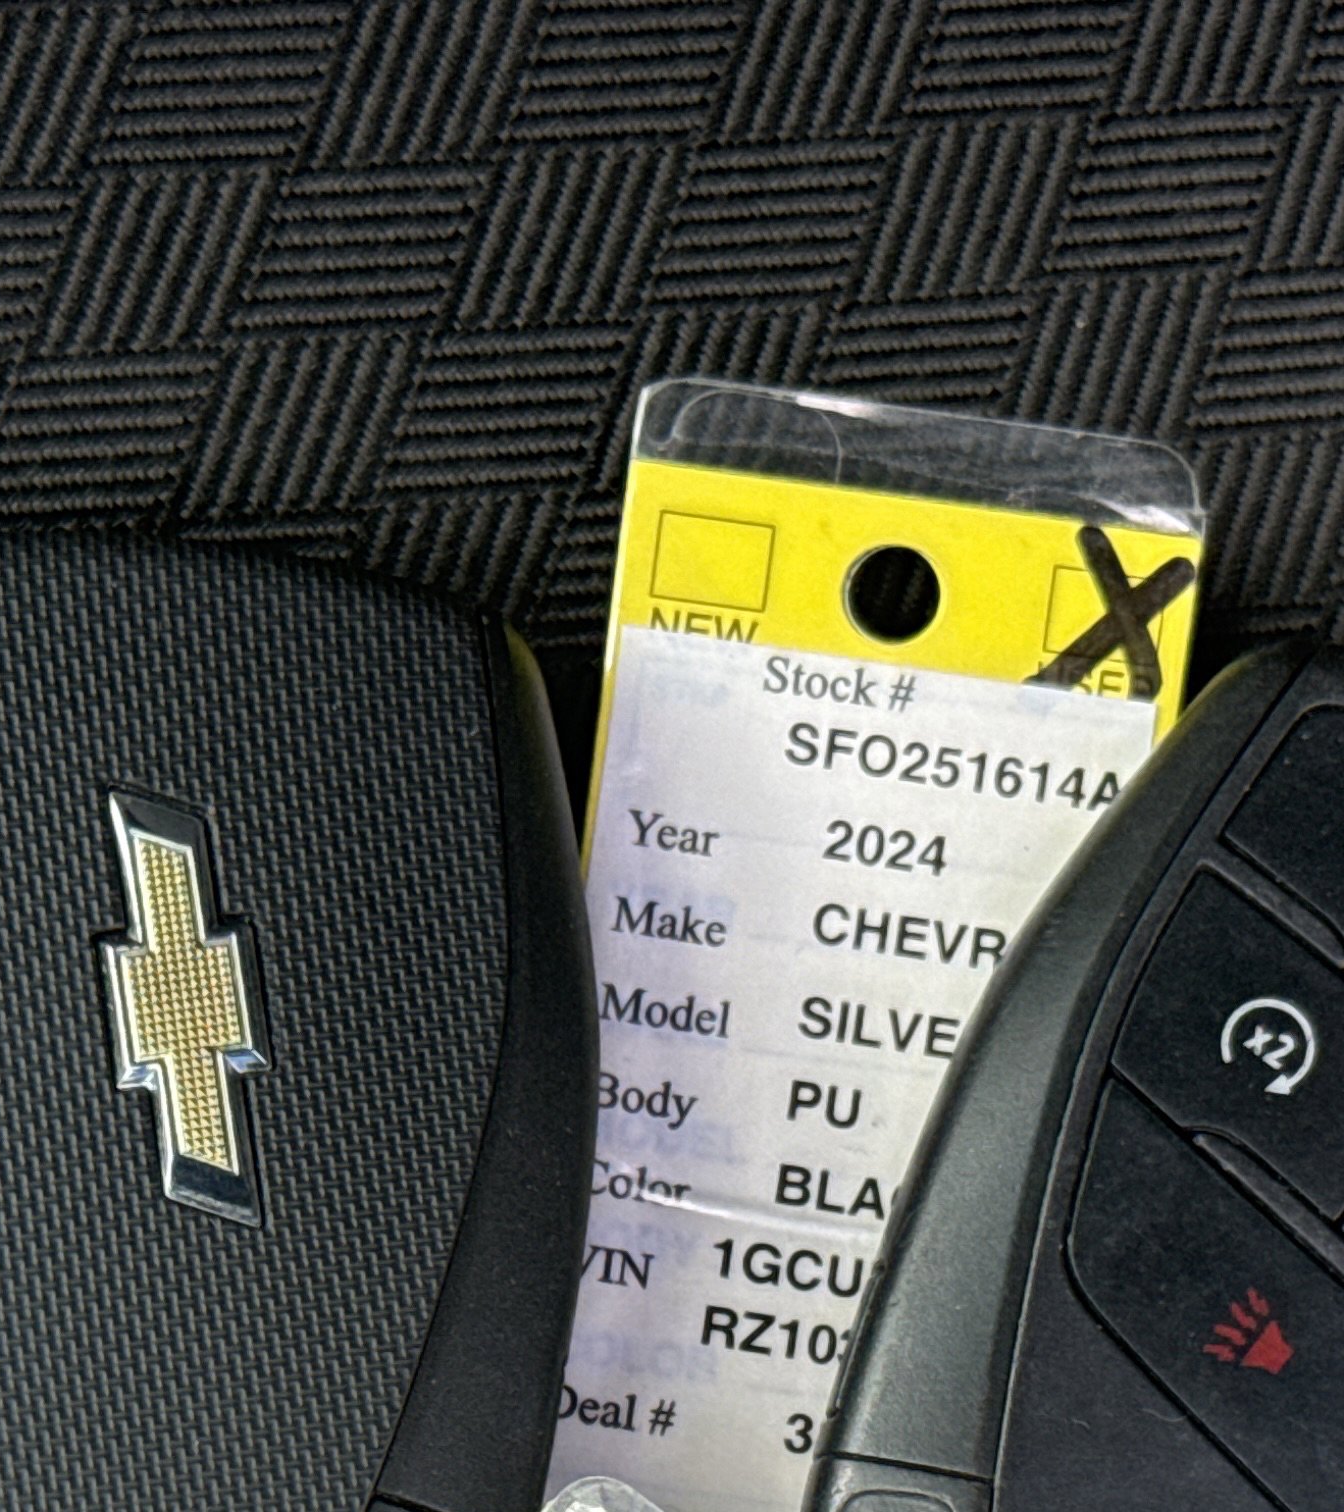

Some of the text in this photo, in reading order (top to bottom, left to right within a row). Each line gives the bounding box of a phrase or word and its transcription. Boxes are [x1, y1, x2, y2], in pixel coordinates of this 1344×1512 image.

[650, 606, 759, 643] NEW
[763, 656, 877, 707] Stock
[889, 675, 915, 711] #
[785, 723, 1122, 813] SFO251614A
[628, 808, 947, 876] Year 2024
[611, 896, 726, 946] Make
[599, 982, 729, 1037] Model
[1242, 1024, 1296, 1070] x2
[595, 1070, 862, 1130] Body PU
[590, 1155, 899, 1220] Color BLA
[700, 1305, 851, 1366] RZ10
[555, 1384, 636, 1432] Deal
[649, 1400, 675, 1436] #
